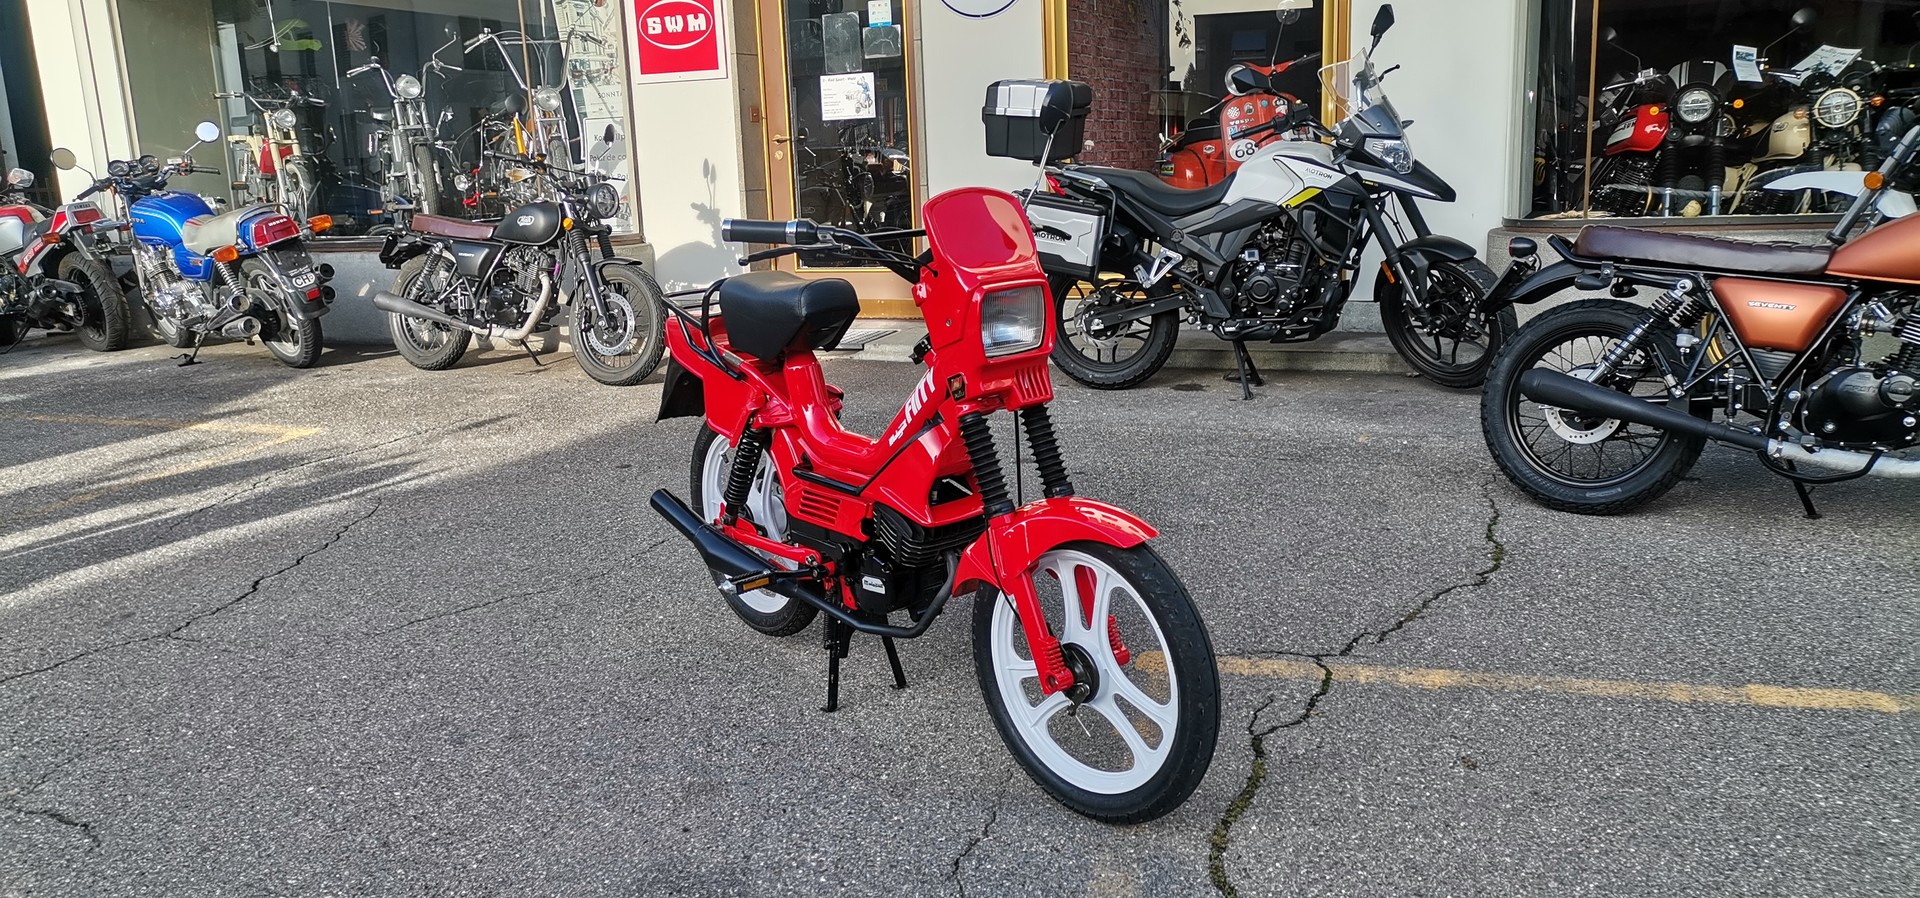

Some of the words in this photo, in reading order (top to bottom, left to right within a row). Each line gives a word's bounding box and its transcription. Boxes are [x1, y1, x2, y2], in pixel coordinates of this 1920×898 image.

[646, 13, 707, 34] SWM
[1235, 142, 1255, 158] 68
[1305, 167, 1333, 180] MOTRON
[294, 274, 311, 286] CH
[1747, 301, 1796, 311] SEVENTY
